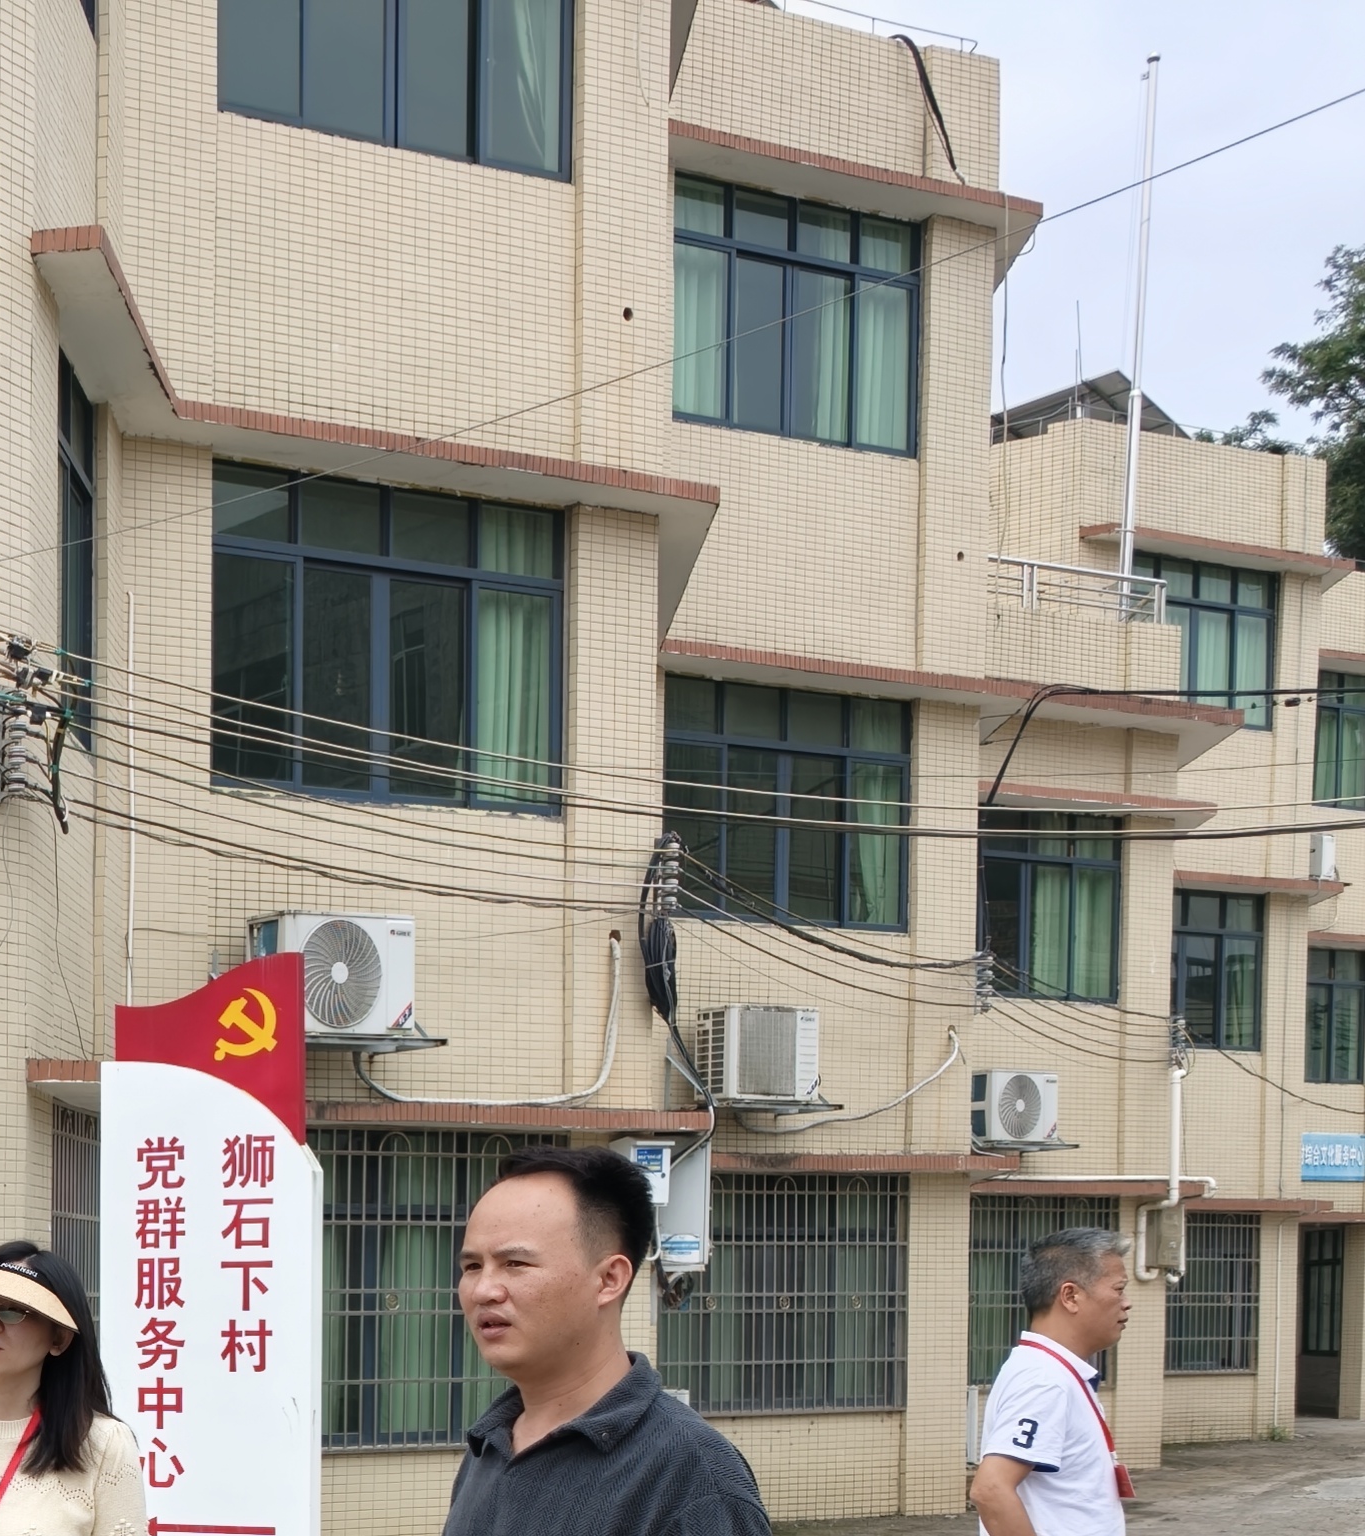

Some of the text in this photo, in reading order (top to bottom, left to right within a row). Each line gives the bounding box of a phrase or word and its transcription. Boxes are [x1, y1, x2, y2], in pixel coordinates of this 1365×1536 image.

[134, 1136, 186, 1489] 党群服务中心
[220, 1133, 276, 1373] 狮石下村
[1012, 1418, 1039, 1449] 3
